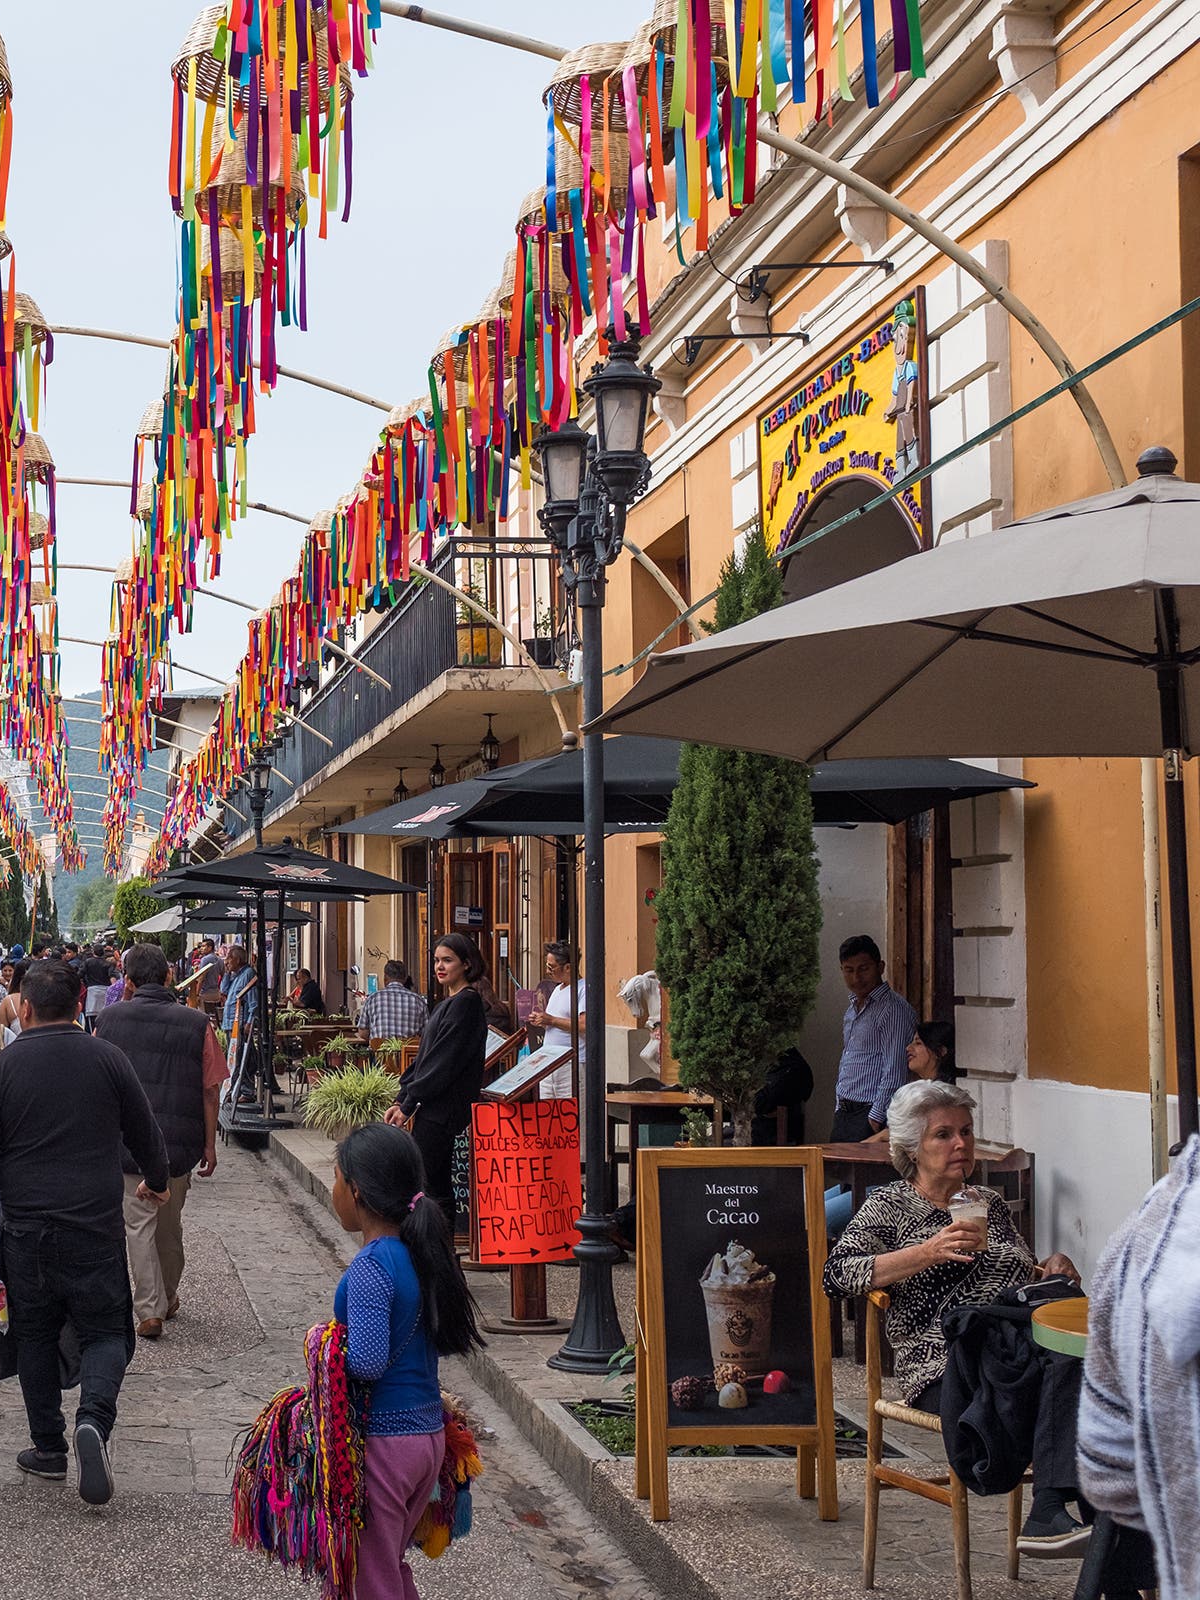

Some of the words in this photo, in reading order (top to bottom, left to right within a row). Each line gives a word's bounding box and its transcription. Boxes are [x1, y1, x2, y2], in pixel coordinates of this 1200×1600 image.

[802, 375, 873, 453] Pescador
[474, 1099, 579, 1137] CREPAS
[475, 1137, 520, 1151] DULCES
[523, 1136, 535, 1150] &
[535, 1134, 579, 1150] SALADAS
[476, 1156, 554, 1184] CAFFEE
[477, 1180, 572, 1214] MALTEADA
[705, 1184, 759, 1195] Maestros
[725, 1198, 740, 1208] del
[479, 1205, 582, 1243] FRAPUCCINO
[706, 1209, 760, 1225] Cacao
